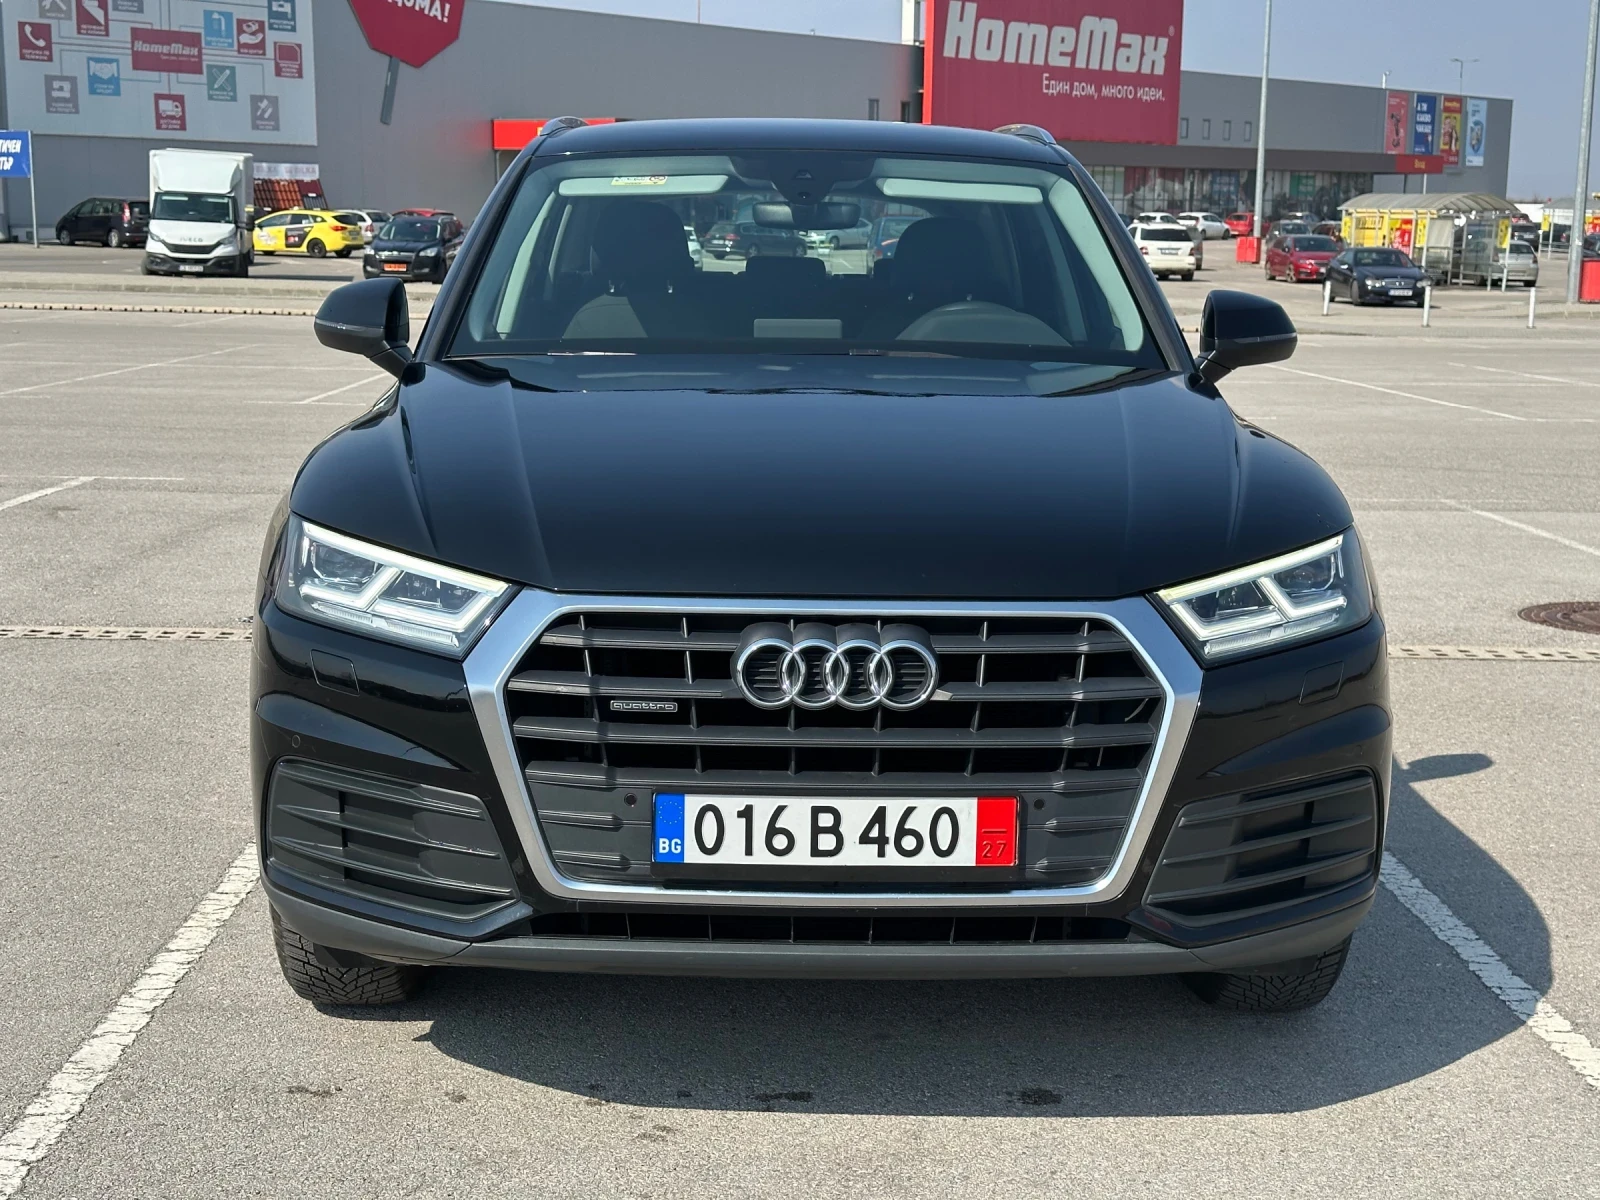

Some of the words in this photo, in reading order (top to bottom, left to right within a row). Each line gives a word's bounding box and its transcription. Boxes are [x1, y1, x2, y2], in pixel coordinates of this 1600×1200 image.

[943, 0, 1169, 75] HomeMax
[133, 40, 199, 56] HomeMax
[1042, 73, 1071, 94] Един
[1072, 81, 1098, 99] дом,
[1101, 84, 1135, 99] много
[1136, 87, 1166, 102] идеи.
[613, 702, 675, 710] quattro
[658, 837, 682, 854] BG
[981, 840, 1008, 859] 27
